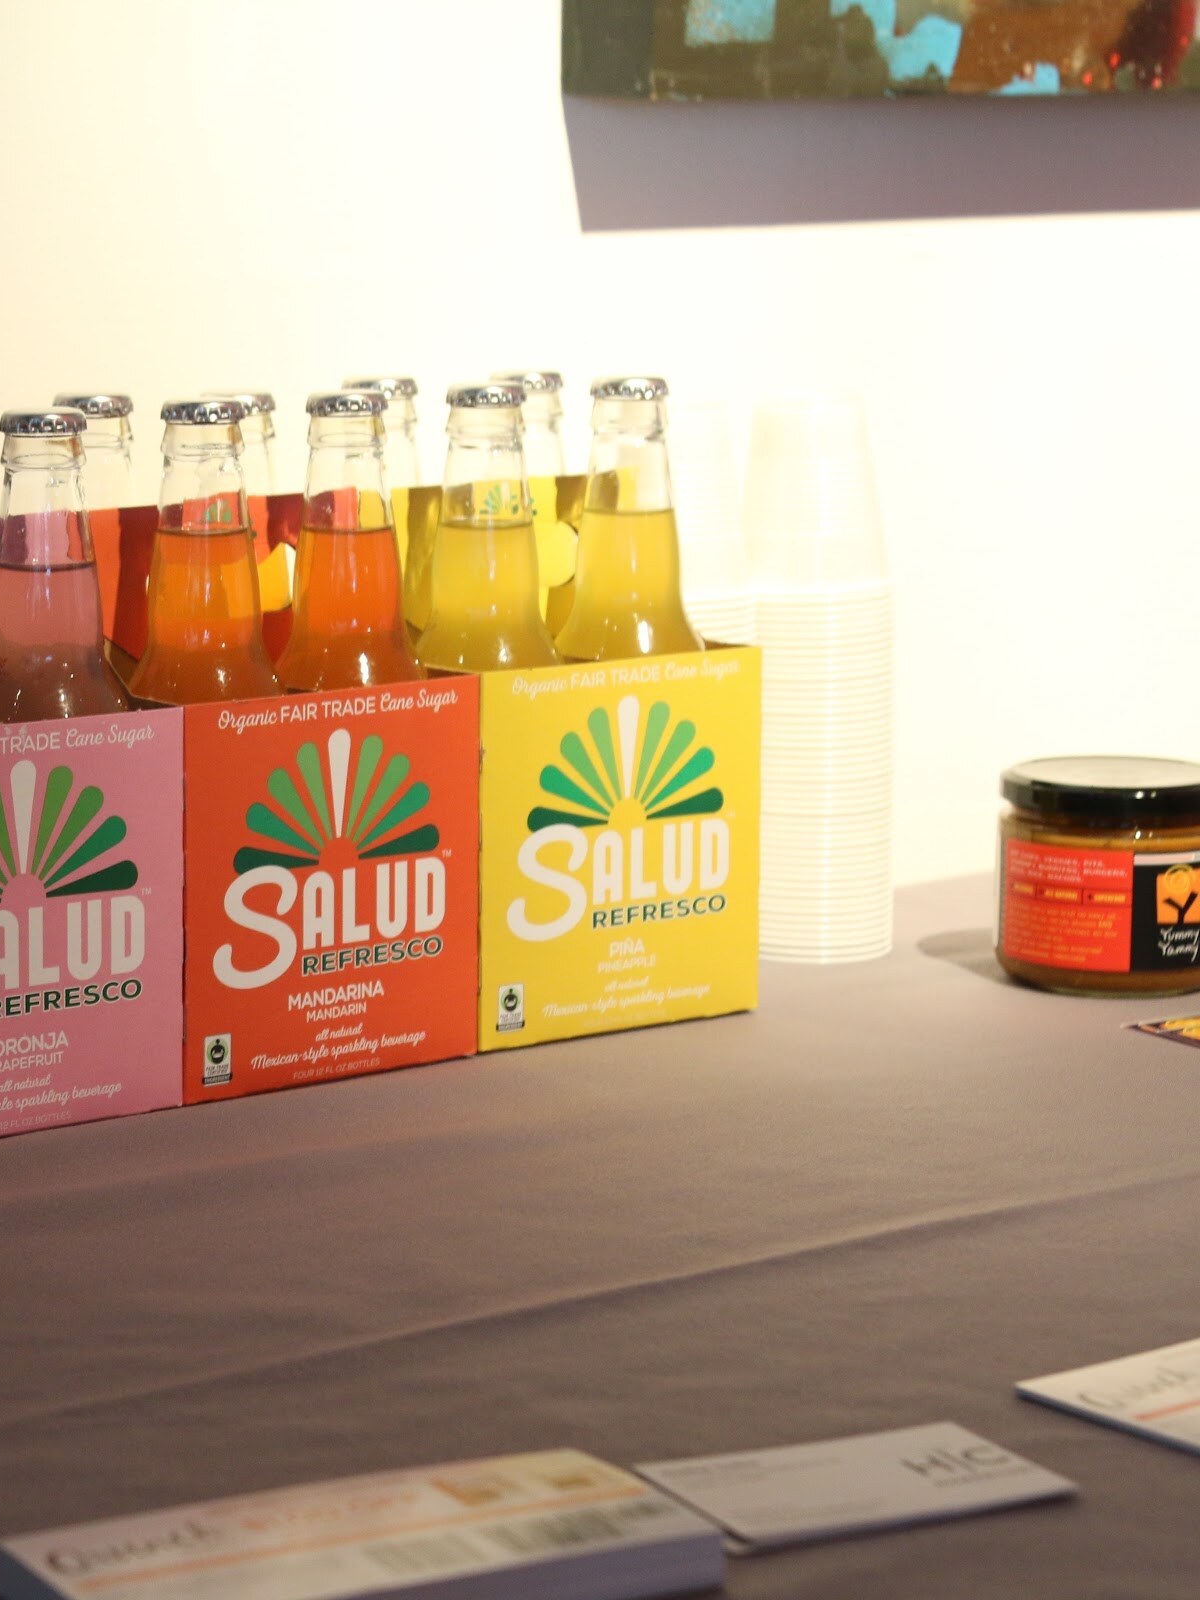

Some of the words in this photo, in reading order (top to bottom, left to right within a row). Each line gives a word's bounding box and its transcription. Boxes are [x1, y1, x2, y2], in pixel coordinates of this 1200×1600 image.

[512, 675, 568, 700] Organic
[571, 671, 606, 689] FAIR
[611, 665, 661, 686] TRADE
[218, 710, 277, 735] Organic
[280, 702, 317, 723] FAIR
[322, 697, 376, 718] TRADE
[380, 693, 414, 712] Cane
[417, 689, 458, 713] Sugar
[0, 732, 60, 755] TRADE
[65, 728, 104, 747] Cane
[108, 724, 155, 749] Sugar
[507, 818, 729, 941] SALUD
[212, 857, 446, 990] SALUD
[592, 894, 726, 929] REFRESCO
[609, 937, 645, 958] PIÑA
[1158, 940, 1199, 962] Yammy
[1160, 926, 1200, 945] Yummy
[302, 936, 444, 976] REFRESCO
[598, 955, 656, 973] PINEAPPLE
[288, 980, 384, 1012] MANDARINA
[307, 1002, 366, 1023] MANDARIN
[316, 1029, 329, 1041] all
[330, 1023, 362, 1039] natural
[251, 1045, 329, 1070] Mexican-style
[331, 1037, 379, 1058] sparkling
[381, 1031, 426, 1047] beverage
[14, 1074, 51, 1091] natural
[15, 1090, 69, 1113] sparkling
[72, 1081, 122, 1098] beverage
